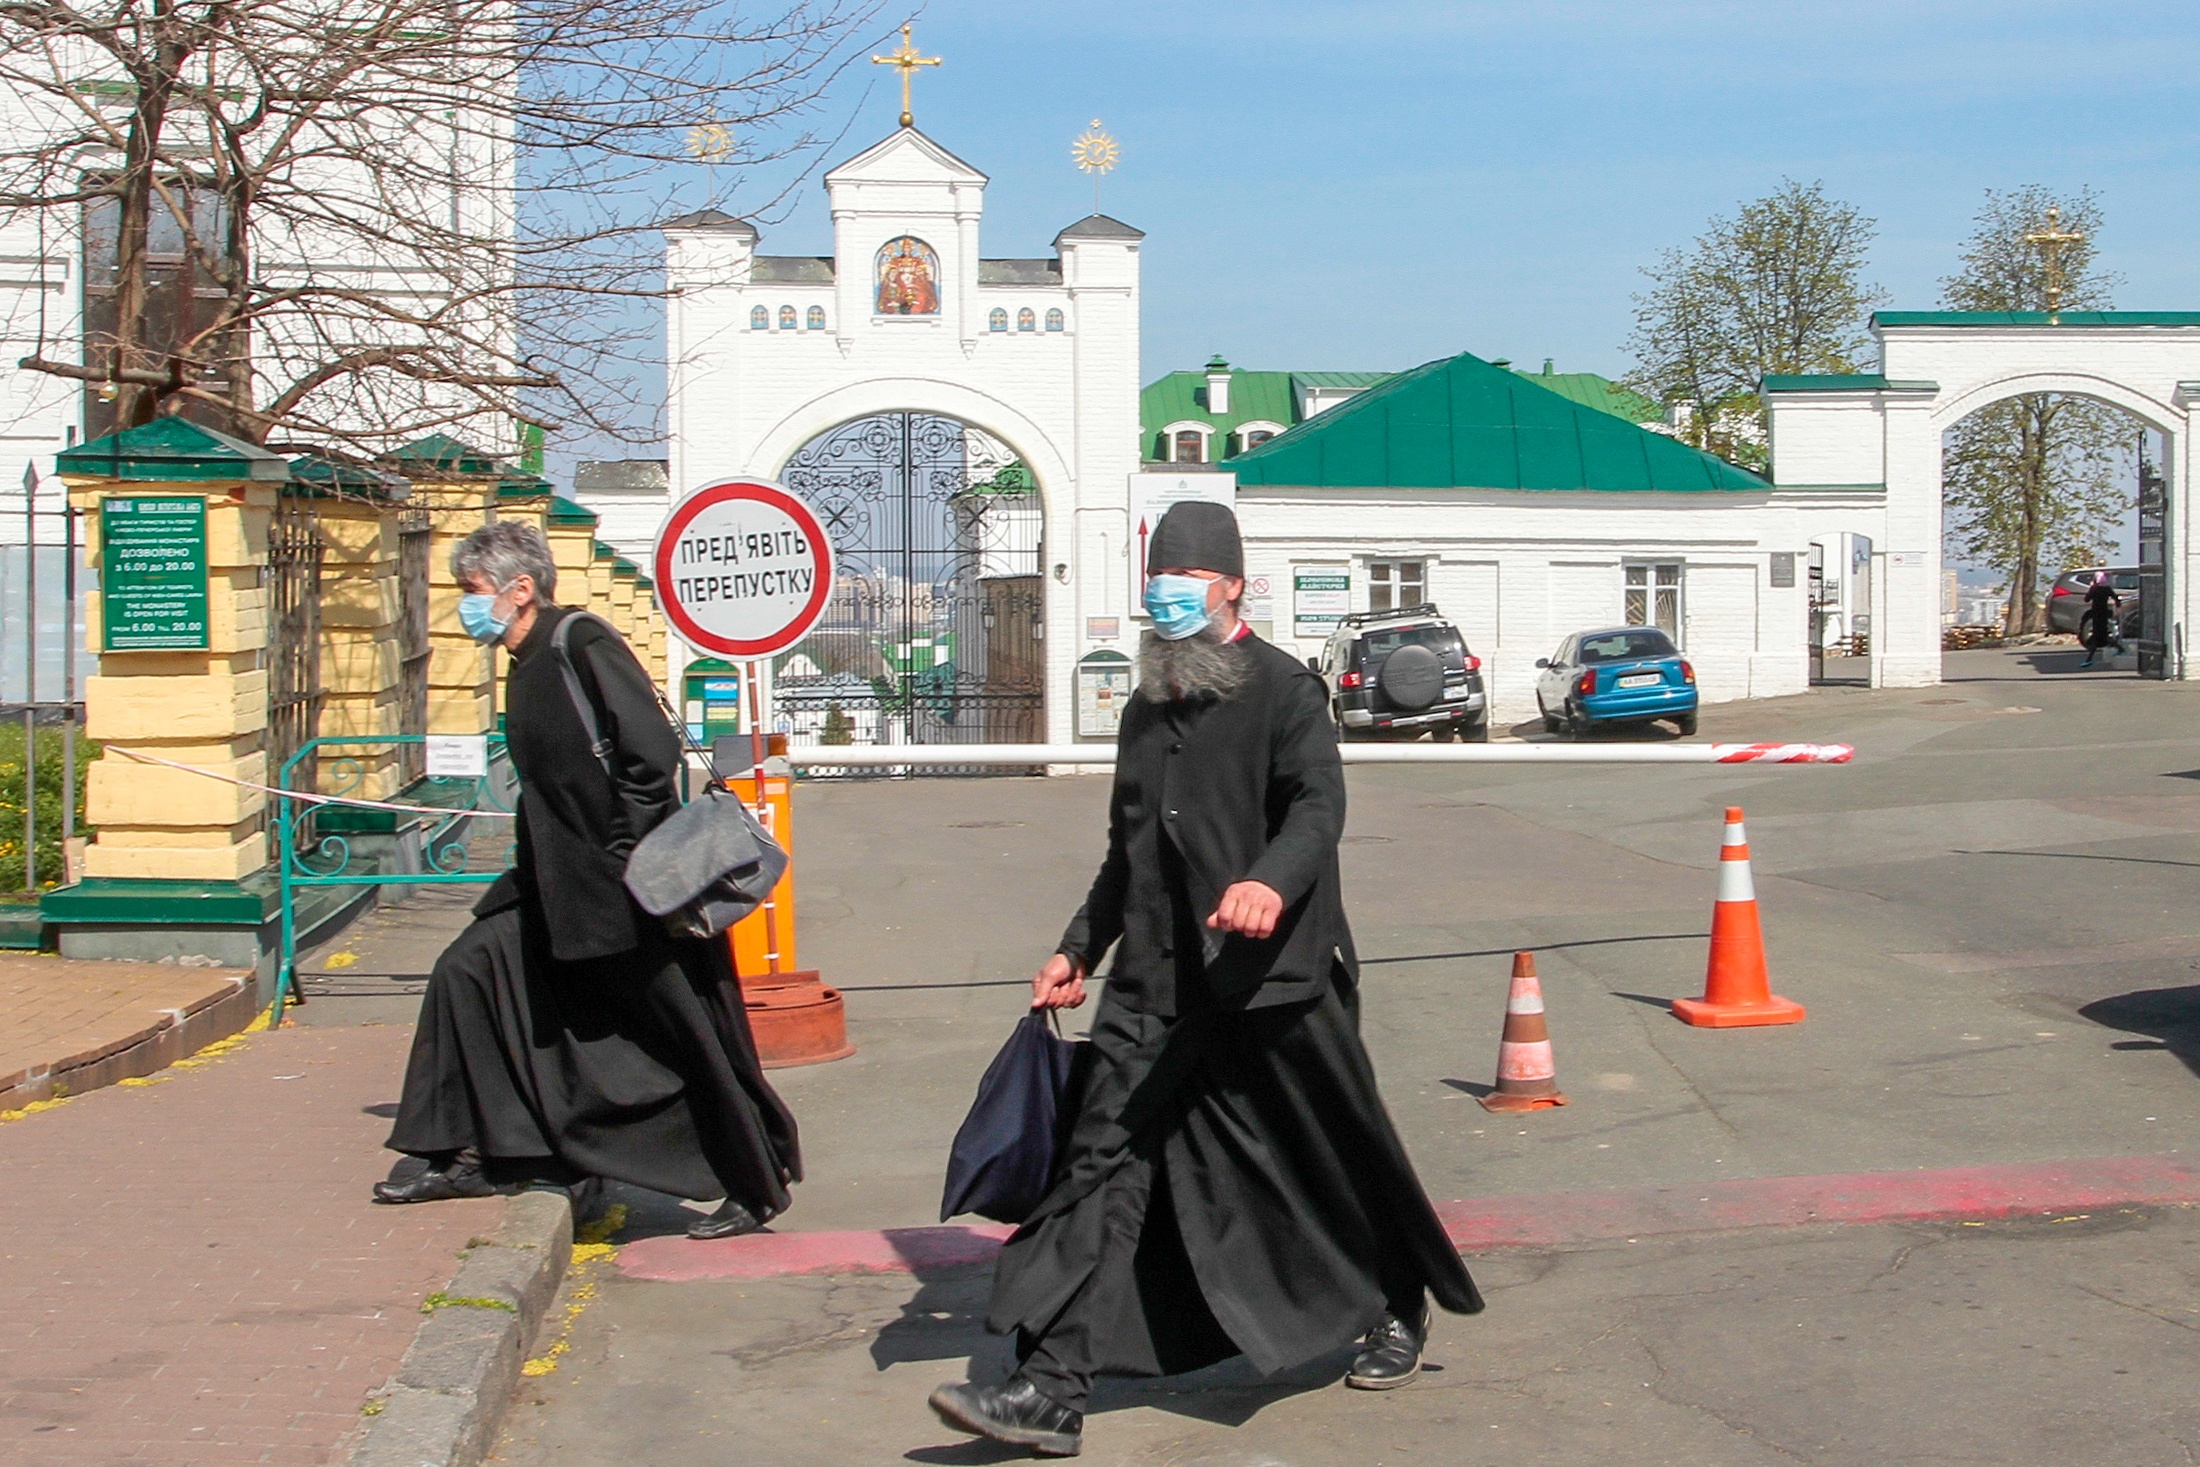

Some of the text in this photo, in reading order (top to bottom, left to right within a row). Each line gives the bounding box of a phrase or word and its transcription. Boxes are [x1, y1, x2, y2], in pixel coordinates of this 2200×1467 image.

[119, 547, 190, 558] ДОЗВОЛЕНО
[681, 530, 807, 566] ПРЕД'ЯВІТЬ
[123, 562, 148, 572] 6.00
[165, 561, 196, 571] 20.00
[679, 567, 813, 603] ПЕРЕПУСТКУ
[131, 622, 156, 632] 6.00
[171, 621, 203, 631] 20.00
